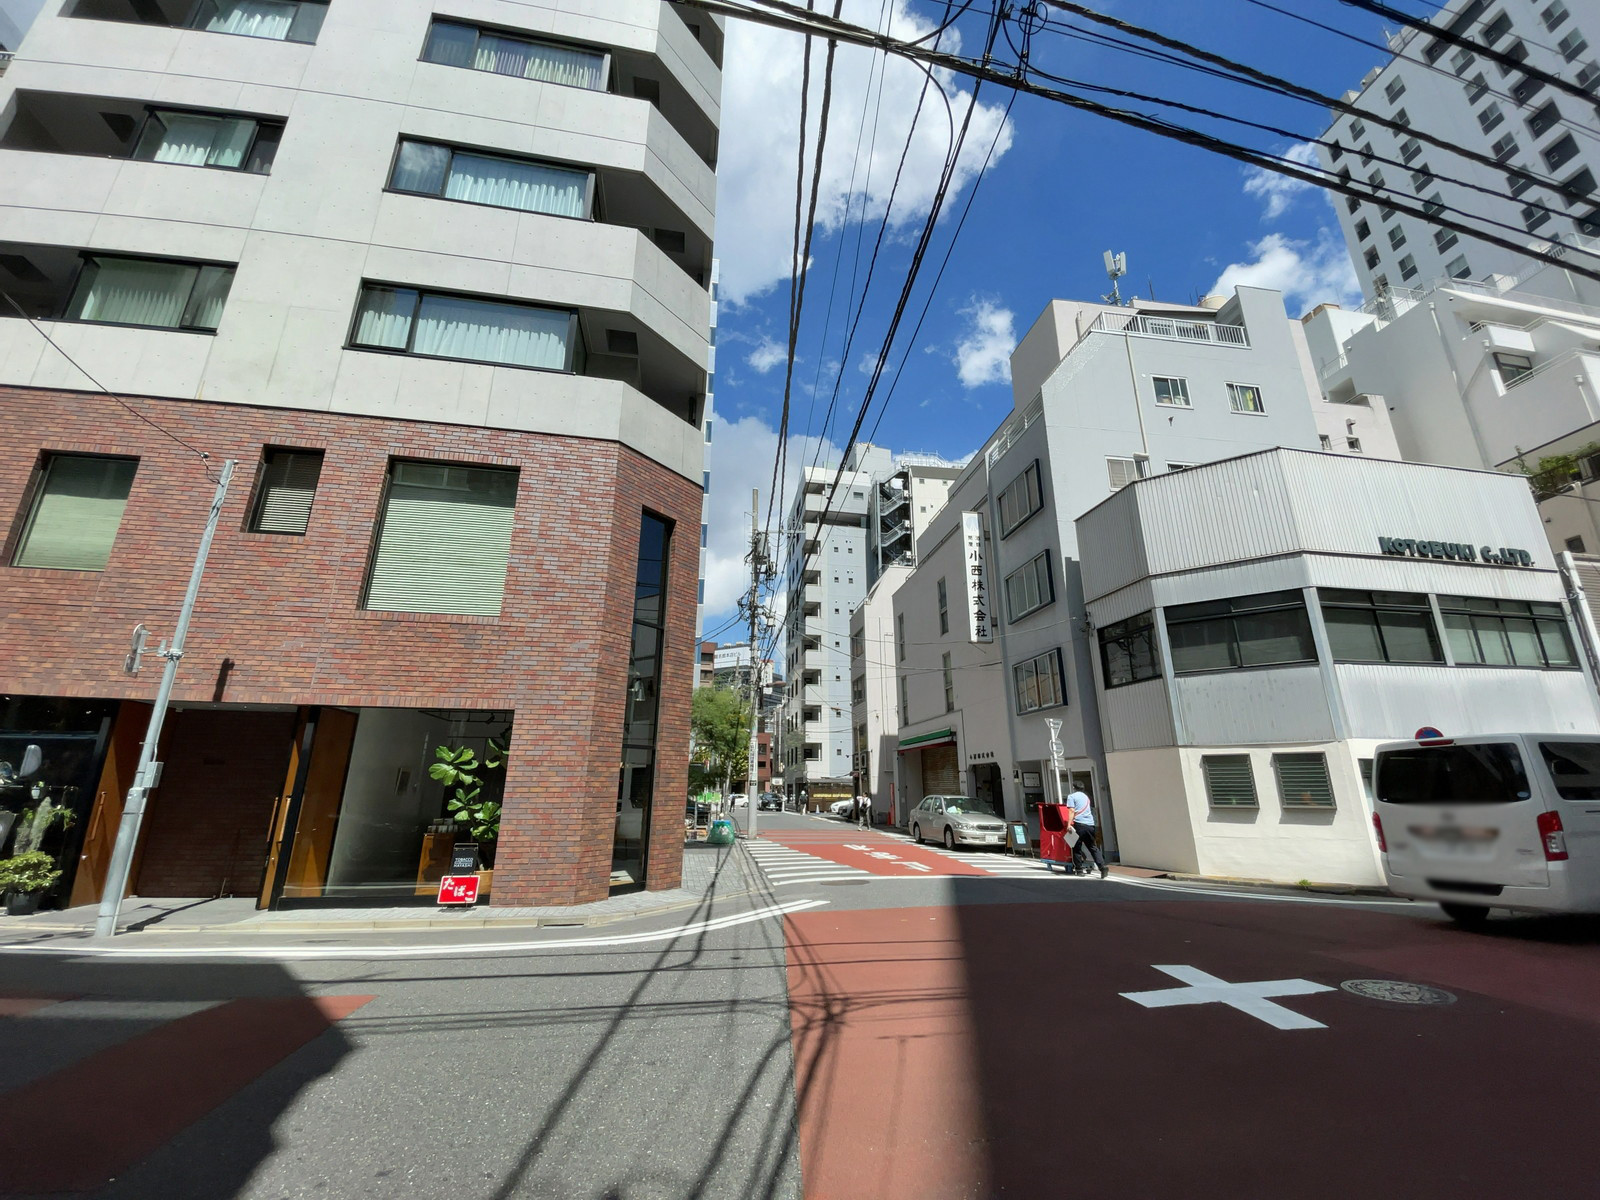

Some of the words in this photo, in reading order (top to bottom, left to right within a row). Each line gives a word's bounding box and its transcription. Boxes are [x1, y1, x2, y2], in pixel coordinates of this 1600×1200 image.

[1378, 536, 1477, 562] KOTOBUKI
[969, 550, 987, 637] 小西株式会社
[442, 877, 474, 901] たばこ
